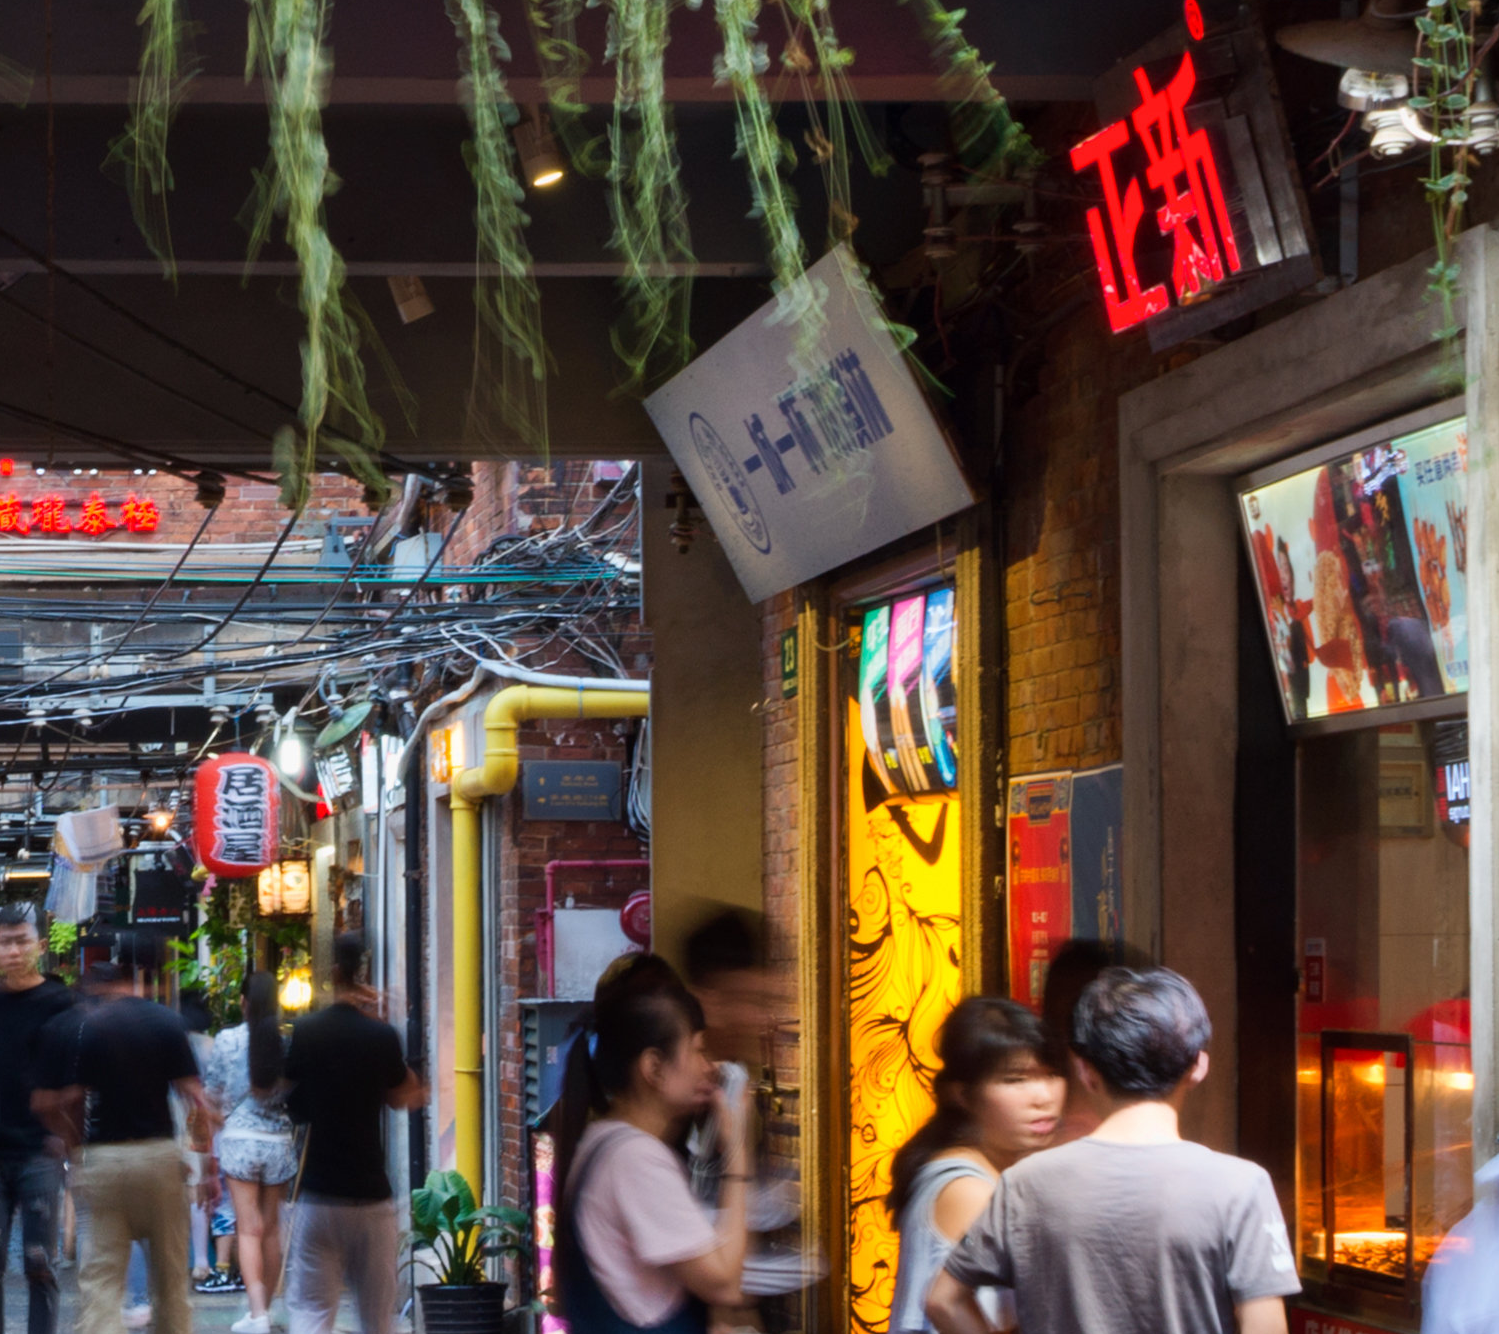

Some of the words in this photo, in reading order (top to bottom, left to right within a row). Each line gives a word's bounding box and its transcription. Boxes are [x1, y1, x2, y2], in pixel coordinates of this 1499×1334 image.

[1070, 50, 1242, 334] 正新
[218, 765, 268, 864] 居酒屋
